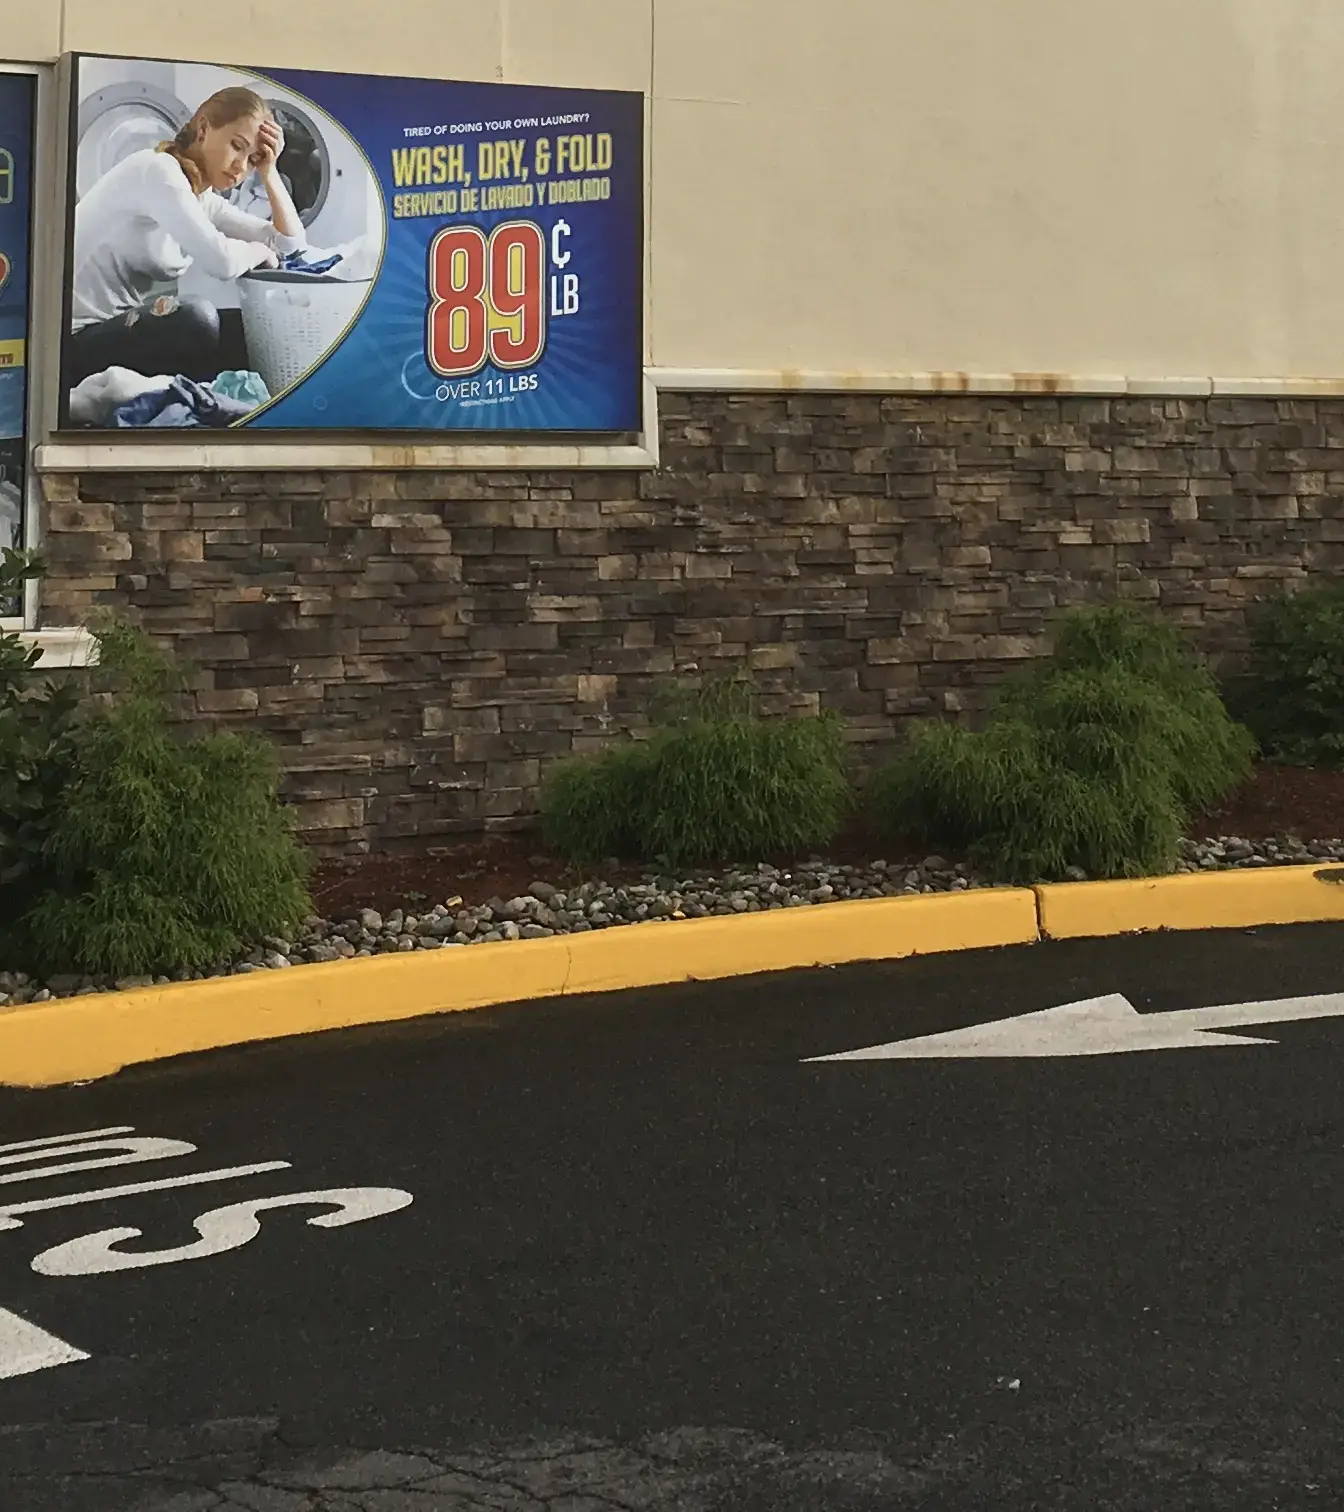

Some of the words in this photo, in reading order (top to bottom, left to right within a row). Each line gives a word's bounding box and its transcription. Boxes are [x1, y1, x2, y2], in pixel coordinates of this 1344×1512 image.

[403, 127, 432, 137] TIRED
[433, 125, 448, 135] OF
[449, 122, 483, 134] DOING
[485, 120, 512, 131] YOUR
[514, 117, 539, 129] OWN
[540, 113, 590, 126] LAUNDRY?
[391, 143, 472, 188] WASH,
[478, 139, 529, 183] DRY,
[556, 132, 613, 173] FOLD
[393, 190, 458, 218] SERVICIO
[460, 187, 479, 213] DE
[481, 183, 534, 211] LAVADO
[536, 182, 546, 206] Y
[548, 177, 611, 205] DOBLADO
[551, 273, 580, 317] LB
[435, 382, 481, 402] OVER
[485, 378, 504, 396] 11
[509, 374, 539, 393] LBS
